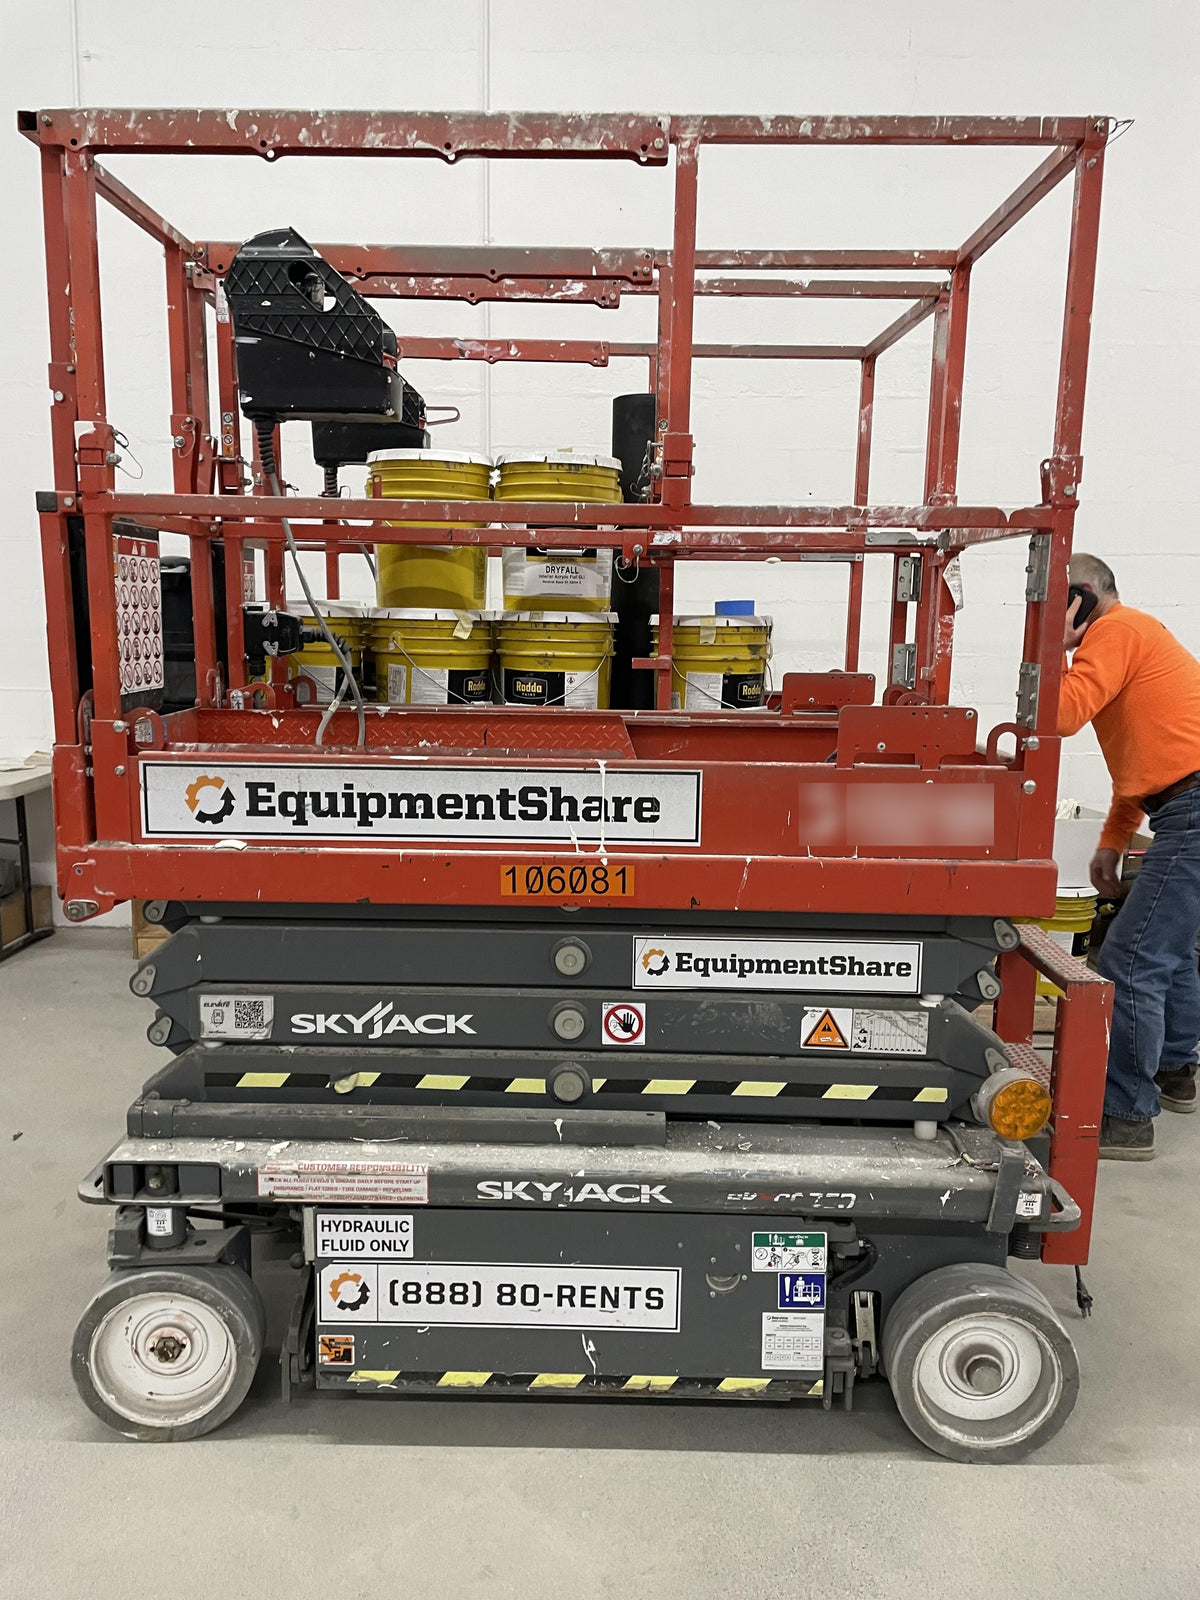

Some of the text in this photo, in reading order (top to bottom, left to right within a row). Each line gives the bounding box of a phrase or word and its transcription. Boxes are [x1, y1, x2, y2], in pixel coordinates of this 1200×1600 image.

[545, 565, 580, 574] DRYFALL
[516, 681, 542, 693] Rodda
[244, 781, 661, 827] EquipmentShare
[505, 865, 627, 895] 106081
[674, 952, 912, 979] EquipmentShare
[290, 1001, 478, 1040] SKYJACK
[297, 1163, 348, 1173] CUSTOMER
[349, 1163, 427, 1174] RESPONSIBILITY
[320, 1220, 410, 1233] HYDRAULIC
[321, 1239, 410, 1252] FLUID ONLY
[388, 1279, 665, 1311] (888) 80-RENTS
